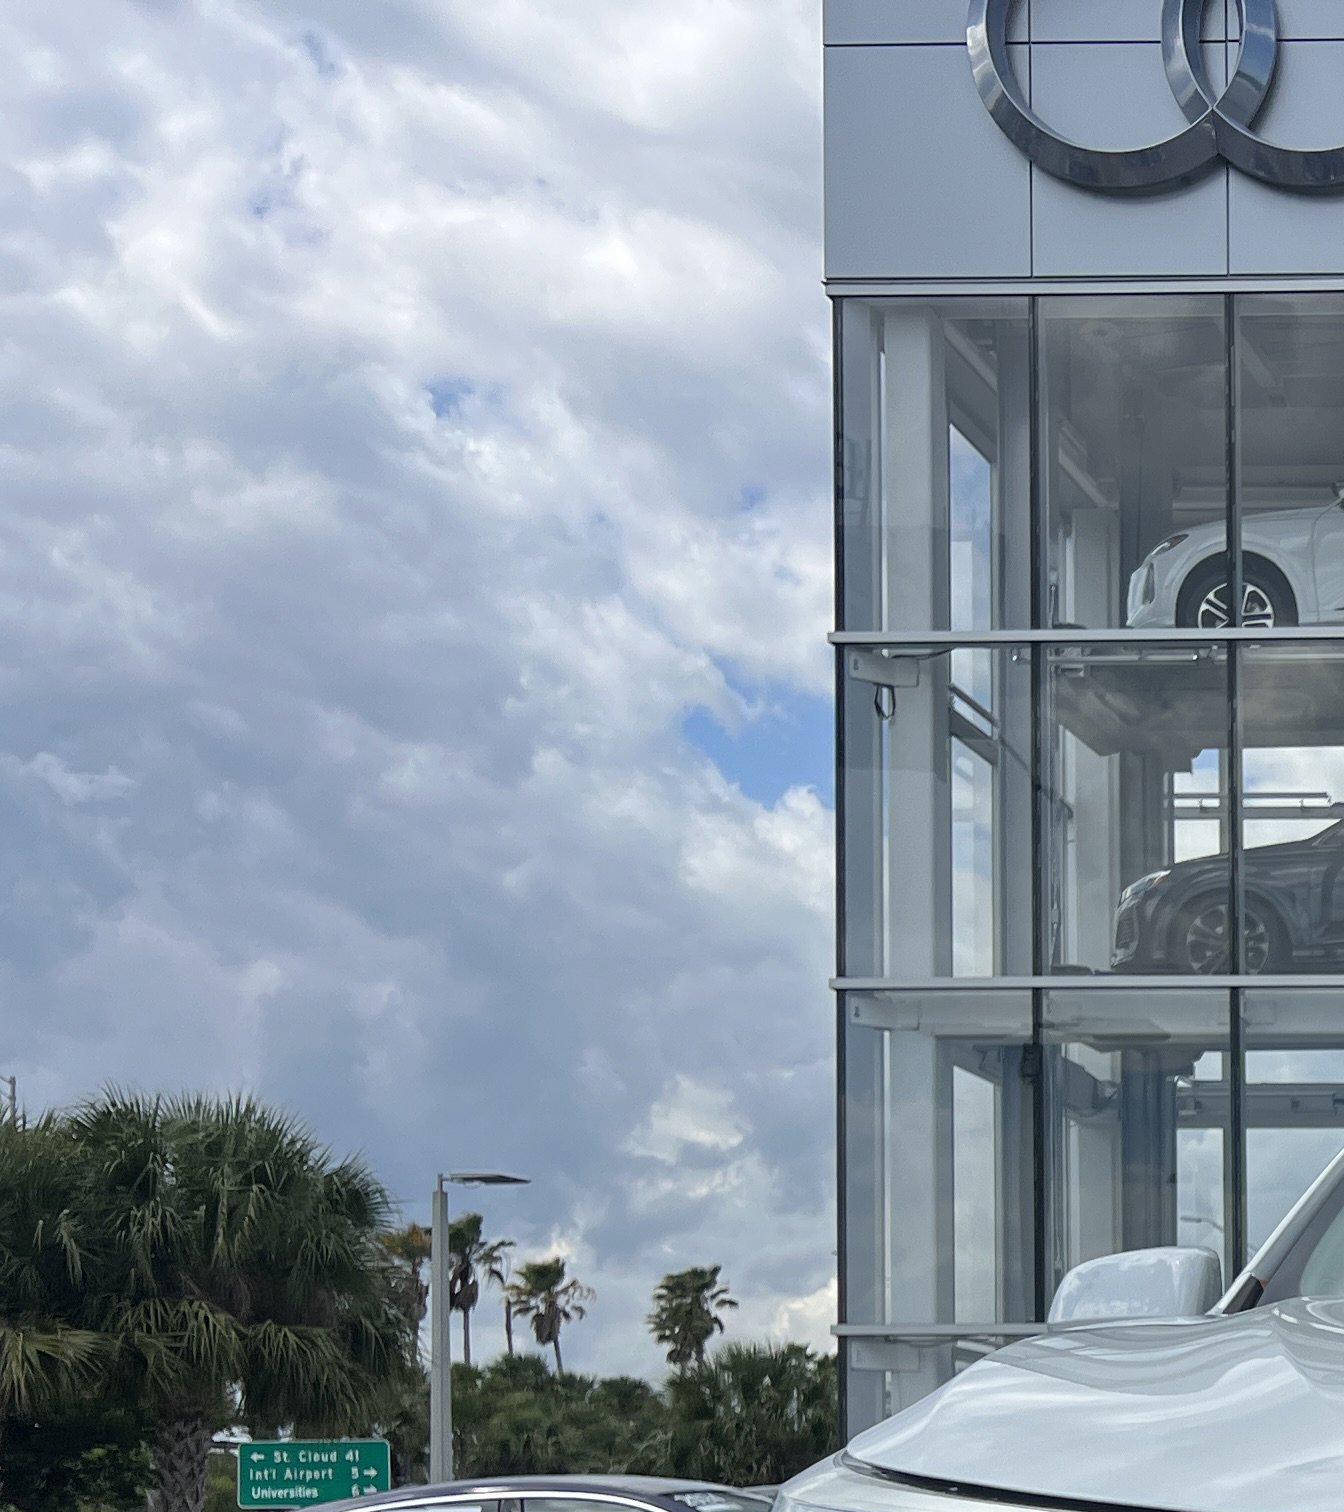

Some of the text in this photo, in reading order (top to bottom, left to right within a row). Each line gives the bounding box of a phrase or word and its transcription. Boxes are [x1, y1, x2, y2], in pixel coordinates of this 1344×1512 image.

[299, 1449, 334, 1463] Cloud
[345, 1449, 359, 1463] 41
[249, 1466, 359, 1482] Int'l Airport 5
[251, 1486, 318, 1499] Universities
